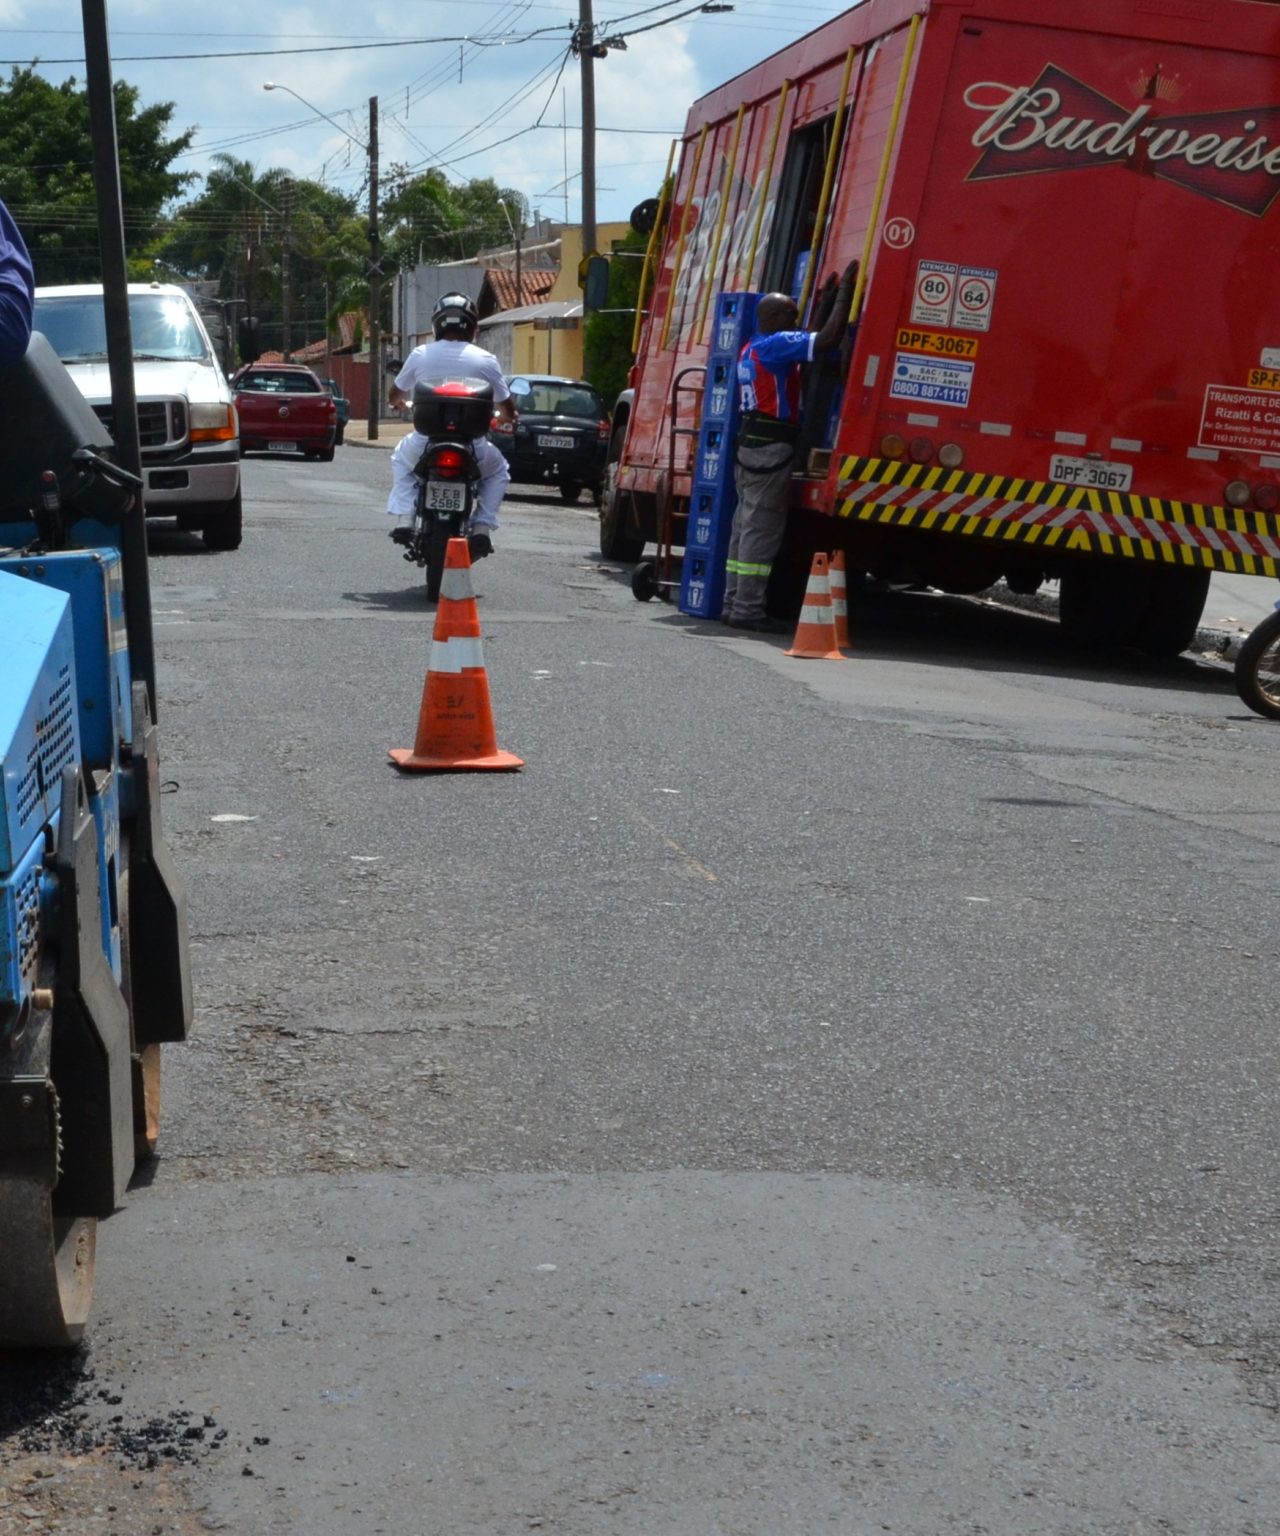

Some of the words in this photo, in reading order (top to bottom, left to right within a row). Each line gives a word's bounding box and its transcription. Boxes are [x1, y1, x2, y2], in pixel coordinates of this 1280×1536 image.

[889, 224, 910, 243] 01
[920, 262, 956, 273] ATENÇÃO
[961, 268, 996, 278] ATENÇÃO
[924, 280, 946, 294] 80
[964, 290, 984, 304] 64
[898, 331, 976, 354] DPF-3067
[908, 374, 938, 384] RIZATTI
[919, 367, 937, 376] SAC
[942, 370, 960, 379] SAV
[893, 381, 919, 396] 0800
[921, 384, 967, 402] 887-1111
[1209, 391, 1268, 408] TRANSPORTE
[1215, 407, 1251, 420] Rizatti
[1252, 411, 1261, 422] &
